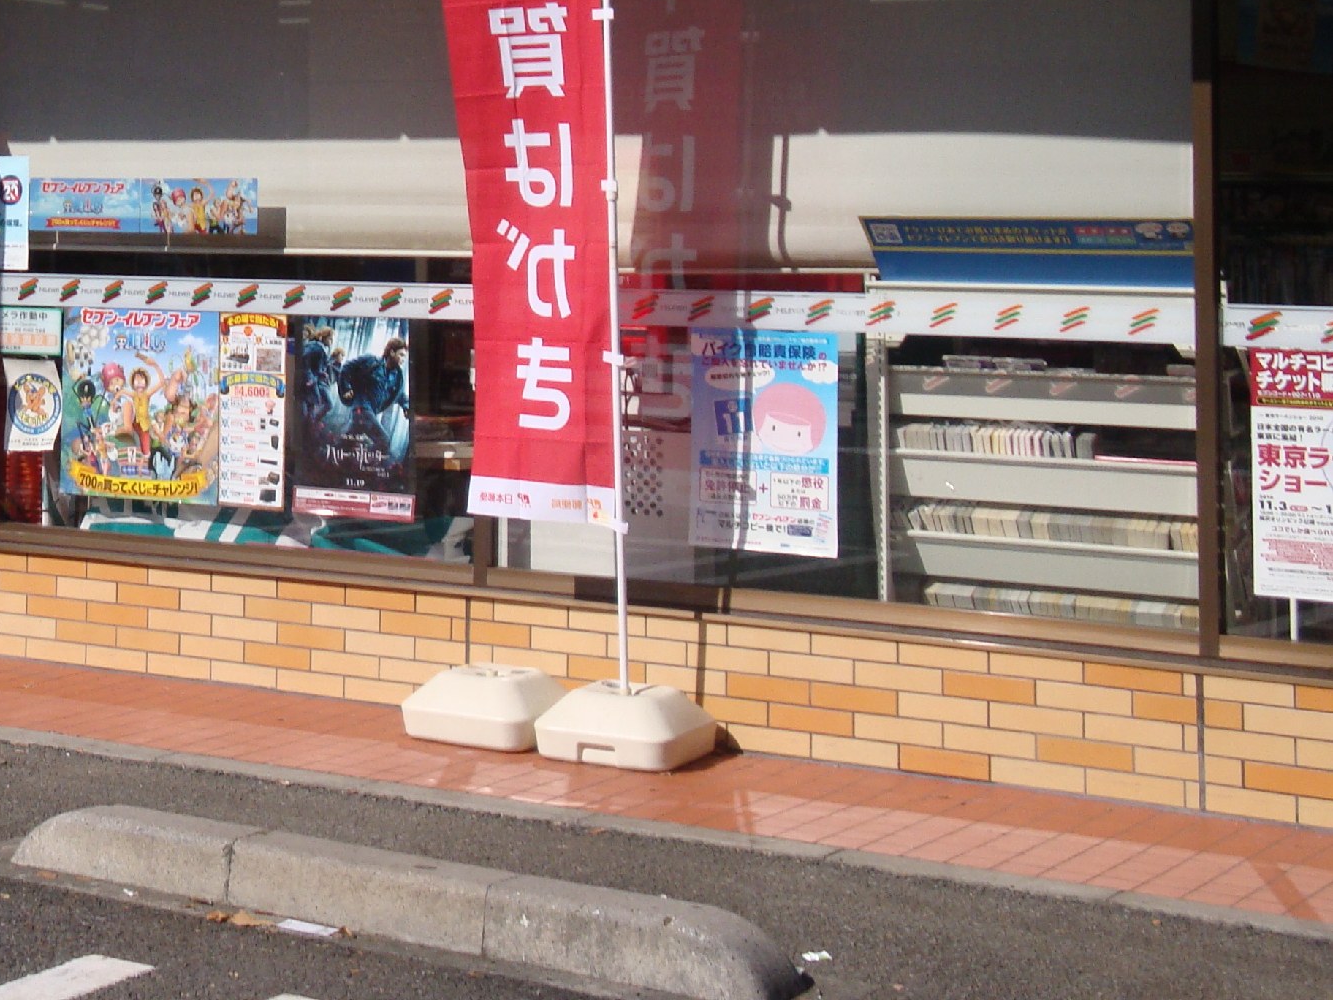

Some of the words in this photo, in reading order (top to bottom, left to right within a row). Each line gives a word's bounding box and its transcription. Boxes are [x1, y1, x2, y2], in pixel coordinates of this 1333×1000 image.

[1257, 443, 1333, 469] 東京ラ
[1259, 469, 1328, 494] ショー
[1259, 500, 1288, 511] 11.3
